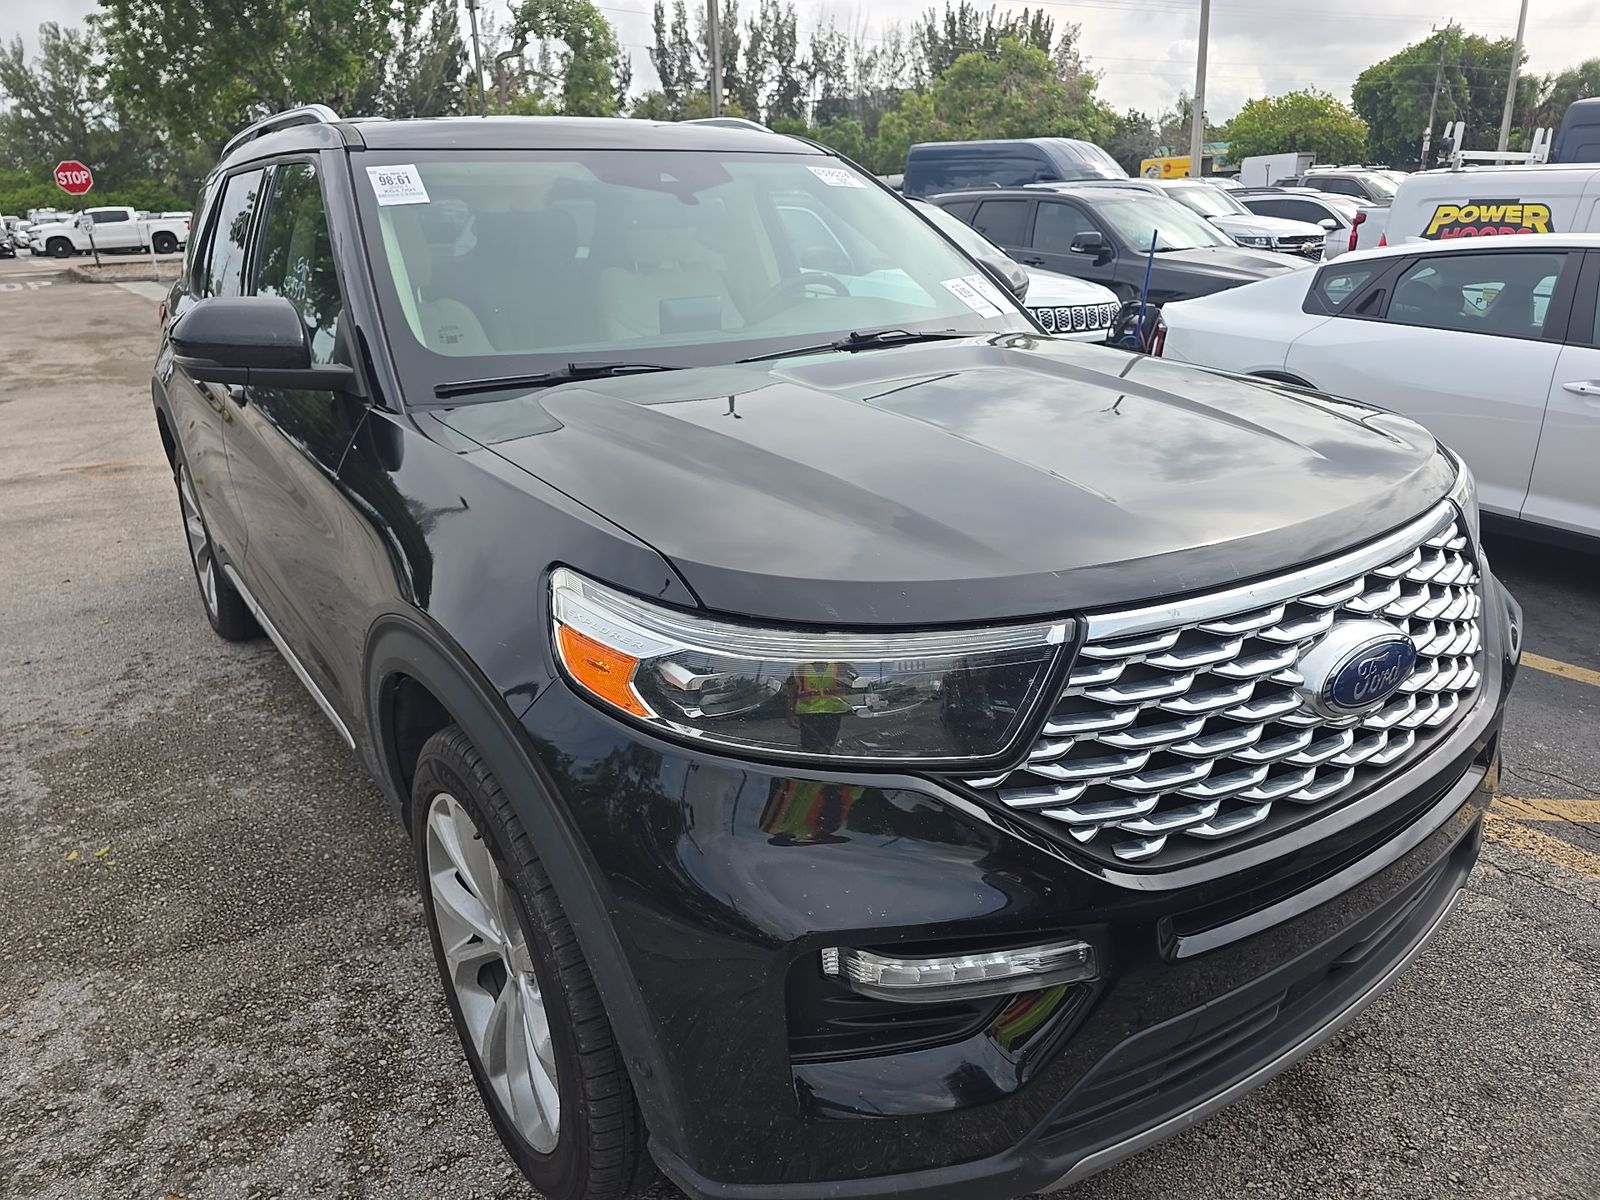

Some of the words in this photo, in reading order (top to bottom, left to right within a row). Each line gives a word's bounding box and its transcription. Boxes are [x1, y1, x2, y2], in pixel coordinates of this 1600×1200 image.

[57, 170, 89, 186] STOP
[378, 175, 412, 186] 98:61
[1426, 204, 1550, 235] POWER
[567, 608, 645, 650] EXPLORER
[1353, 650, 1402, 700] Ford
